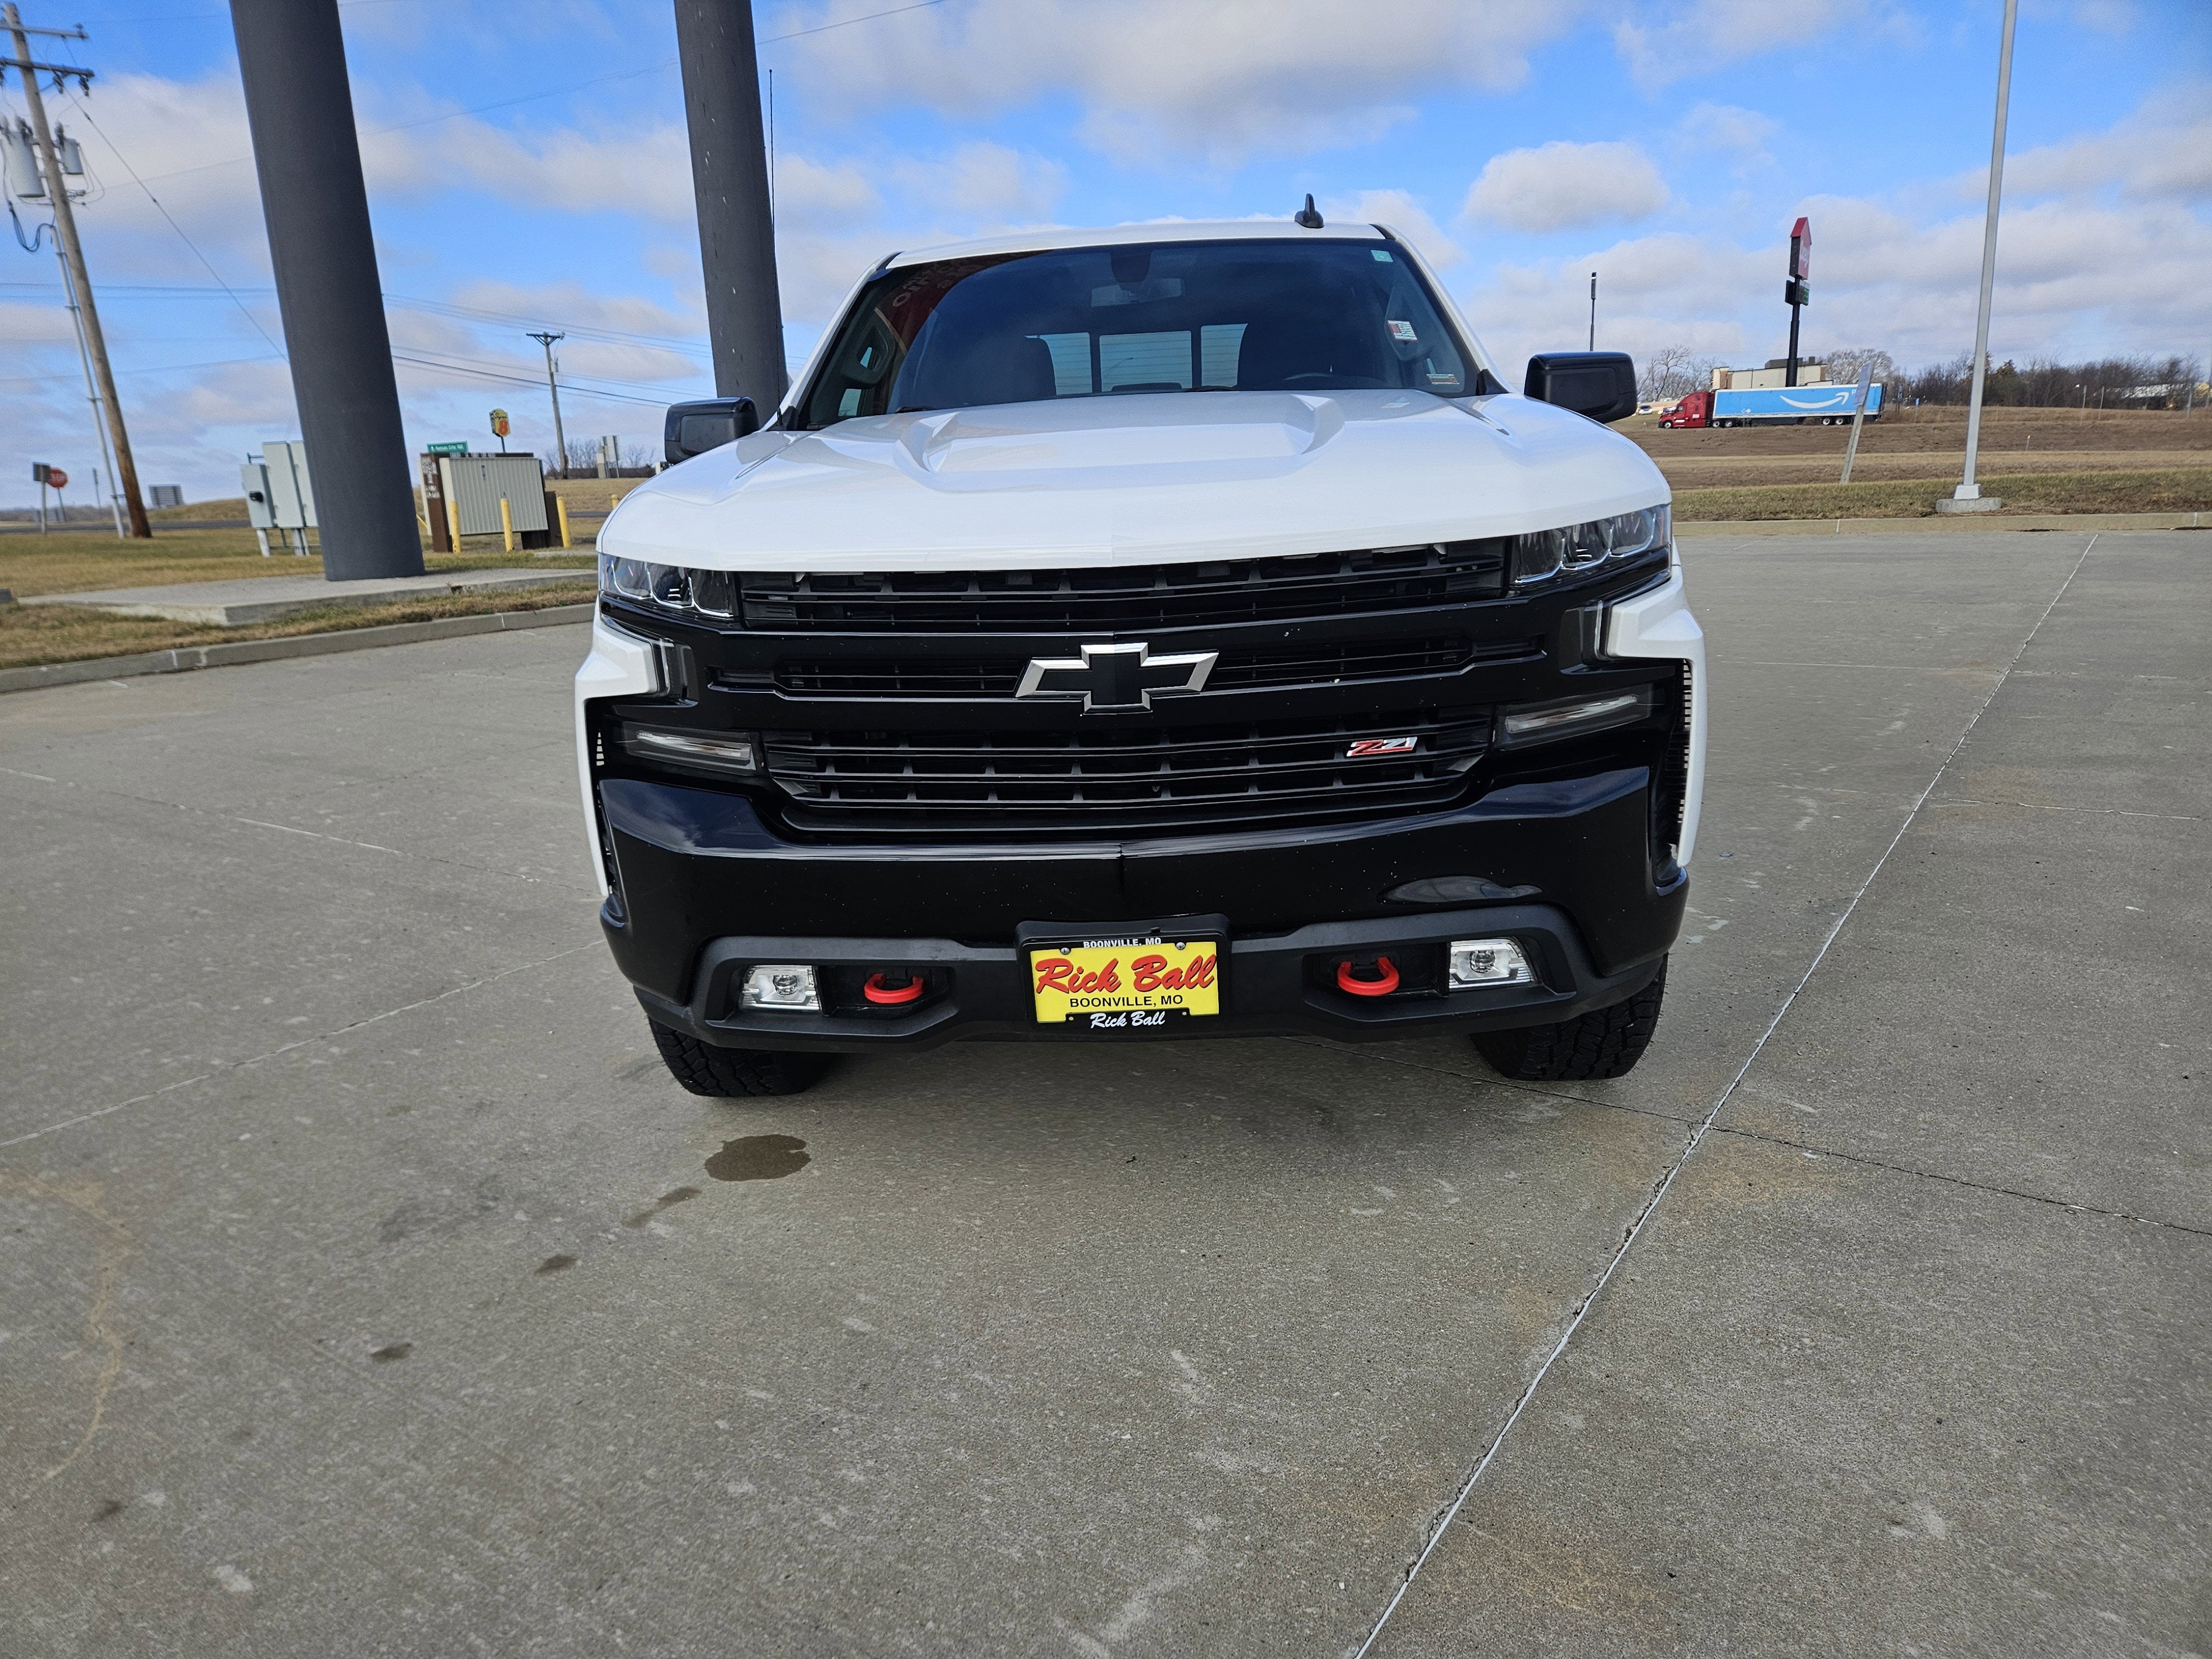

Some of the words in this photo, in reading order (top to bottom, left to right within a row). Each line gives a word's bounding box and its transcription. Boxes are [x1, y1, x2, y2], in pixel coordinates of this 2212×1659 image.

[1347, 736, 1418, 757] Z71
[1083, 938, 1142, 949] BOONVILLE,
[1145, 937, 1162, 946] MO
[1035, 958, 1122, 994] Rick
[1130, 954, 1217, 992] Ball
[1070, 997, 1156, 1008] BOONVILLE,
[1161, 995, 1183, 1005] MO
[1090, 1013, 1128, 1029] Rick
[1131, 1011, 1166, 1026] Ball
